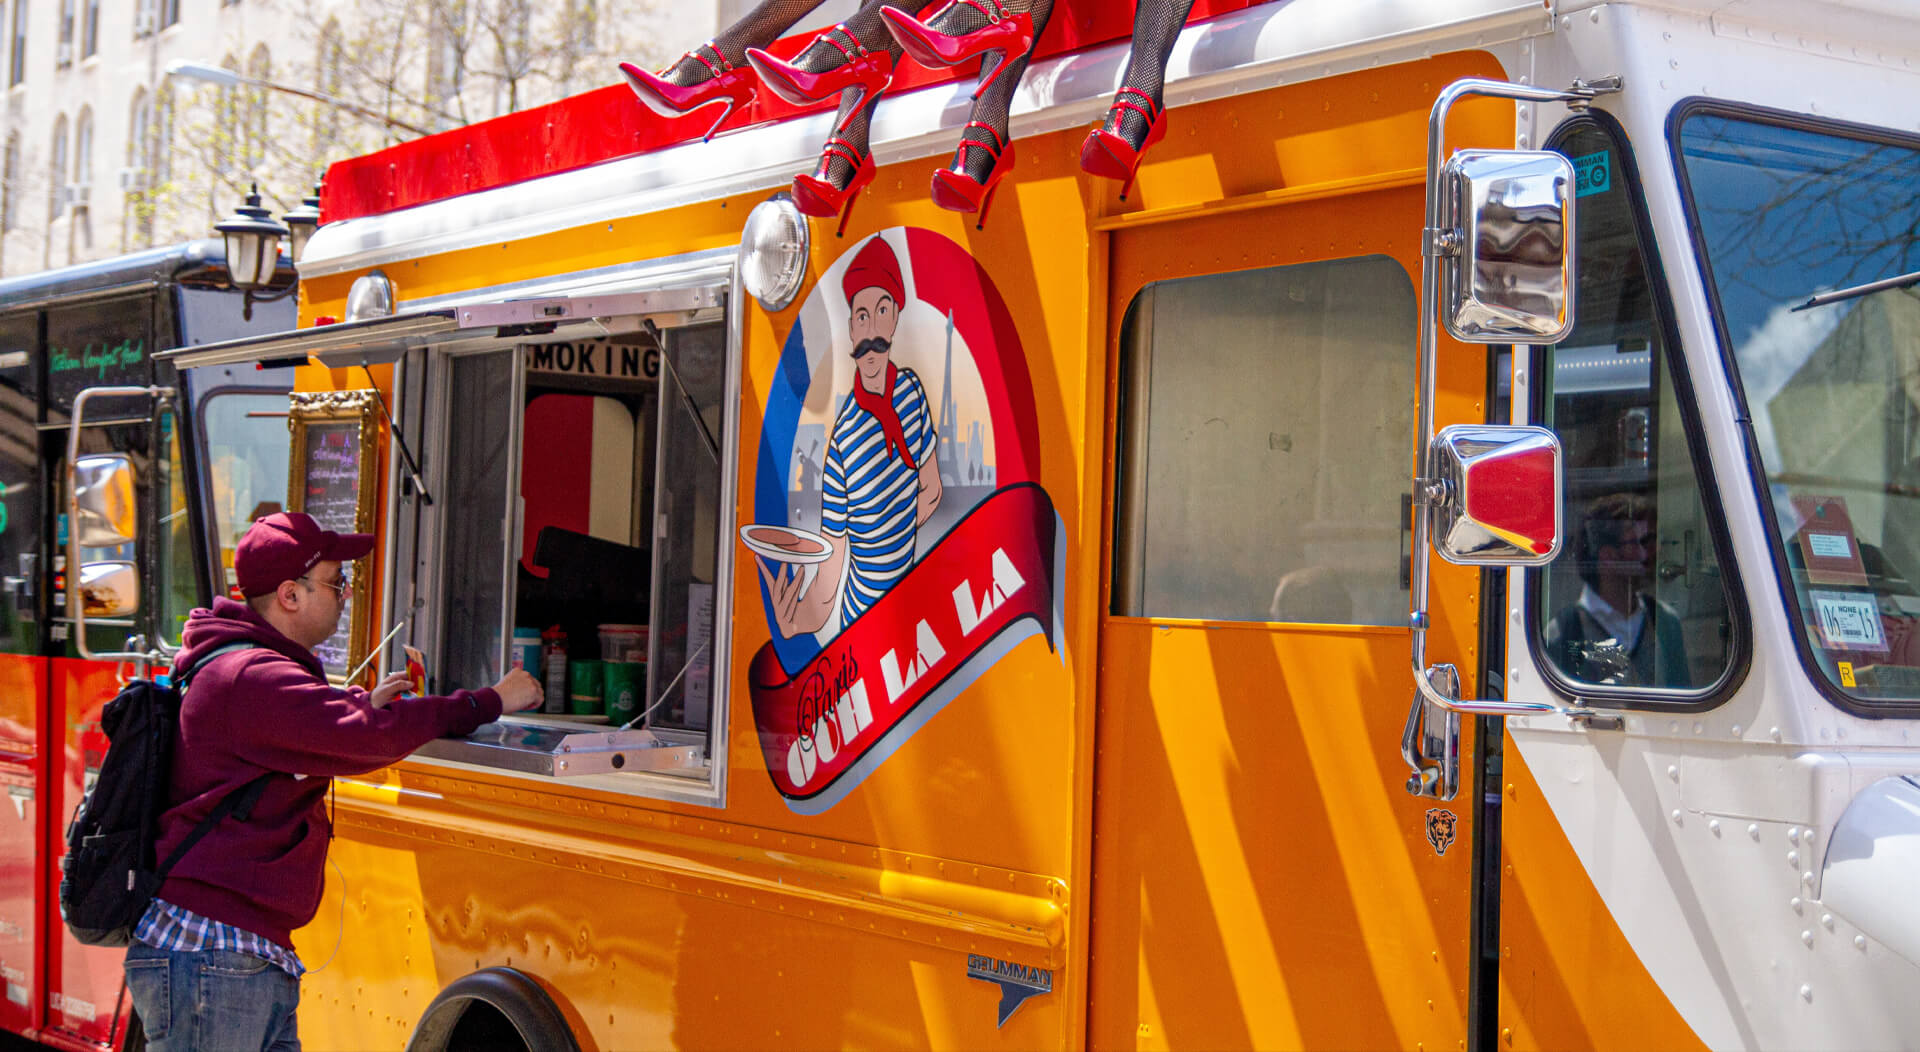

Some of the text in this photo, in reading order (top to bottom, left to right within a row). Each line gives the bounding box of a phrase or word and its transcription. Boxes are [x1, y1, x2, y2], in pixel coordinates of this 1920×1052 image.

[879, 617, 947, 705] LA
[951, 546, 1026, 637] LA
[797, 644, 859, 752] Paris
[1840, 666, 1853, 681] R
[967, 953, 1053, 986] GRUMMAN
